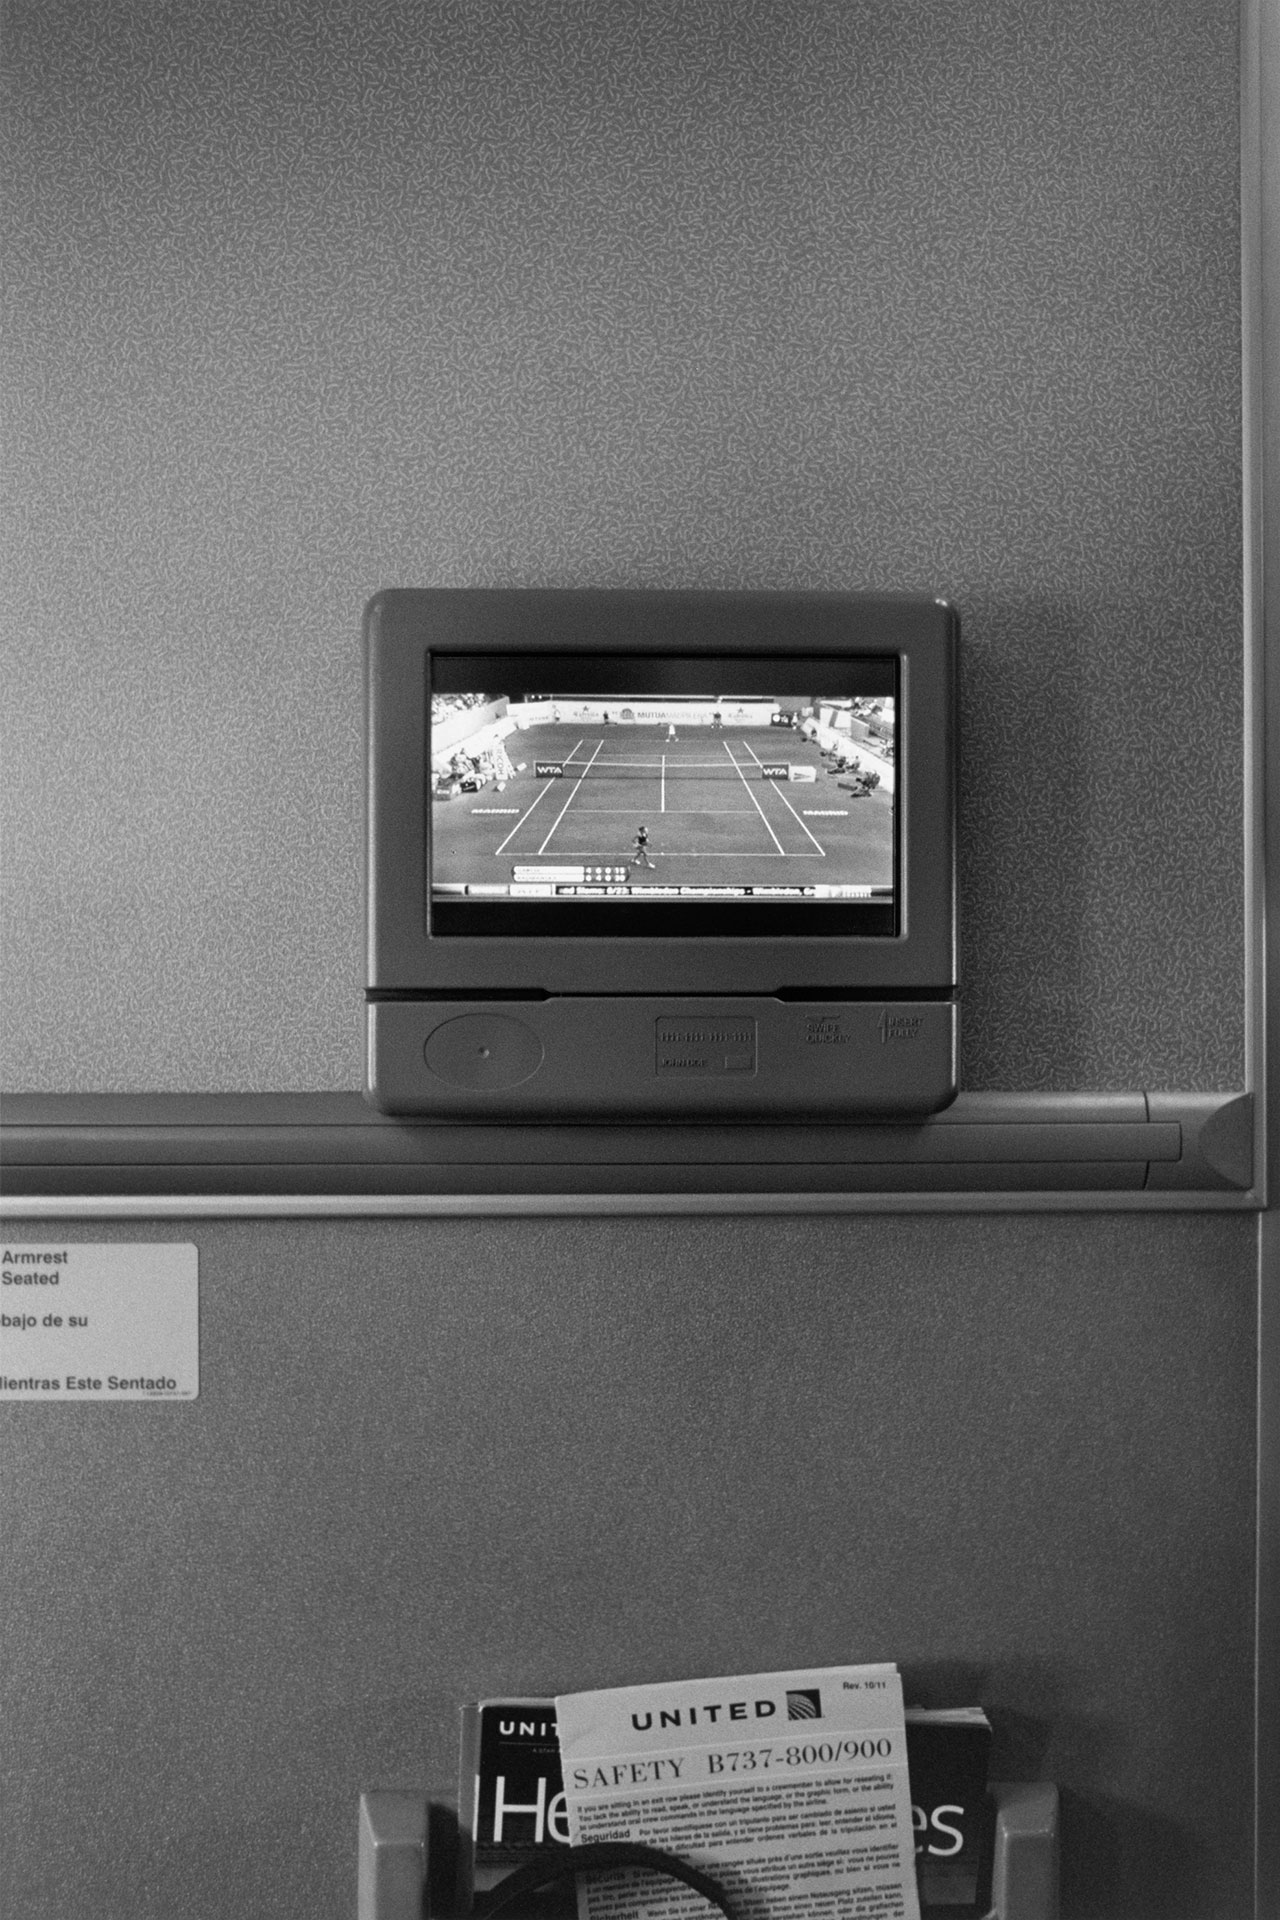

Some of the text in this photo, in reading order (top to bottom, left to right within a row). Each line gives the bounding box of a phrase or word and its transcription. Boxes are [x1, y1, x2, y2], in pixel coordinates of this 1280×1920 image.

[537, 766, 562, 774] WTA
[763, 768, 788, 776] WTA
[2, 1251, 68, 1264] Armrest
[2, 1271, 60, 1285] Seated
[0, 1314, 89, 1330] bajo de su
[0, 1375, 177, 1390] ientras Este Sentado
[843, 1680, 886, 1690] Rev. 10/11
[631, 1700, 776, 1731] UNITED
[573, 1738, 892, 1790] SAFETY B737-800/900
[580, 1828, 631, 1845] Seguridad
